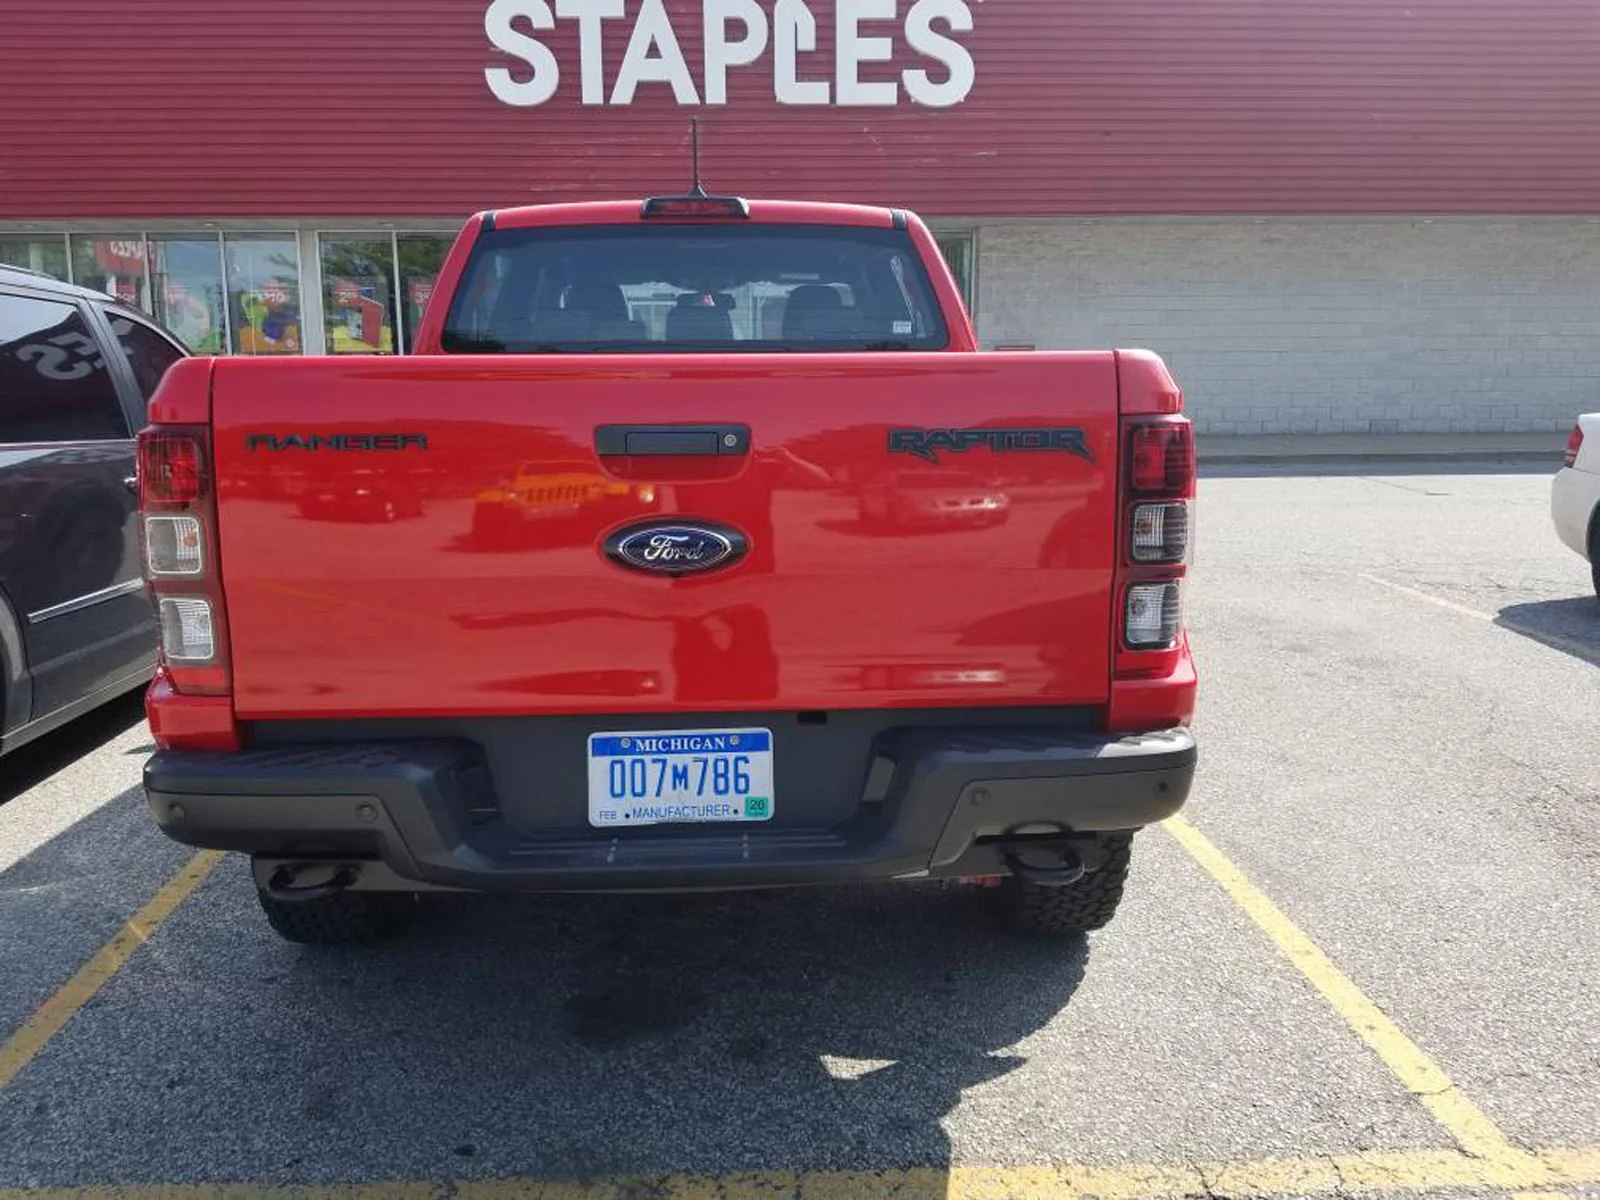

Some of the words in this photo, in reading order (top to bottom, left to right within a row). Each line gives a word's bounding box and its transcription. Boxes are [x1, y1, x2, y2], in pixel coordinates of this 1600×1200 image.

[484, 0, 975, 106] STAPLES
[247, 432, 427, 451] RANGER
[887, 428, 1096, 464] RAPTOR
[643, 534, 704, 560] Ford
[635, 736, 725, 752] MICHIGAN
[609, 755, 750, 798] 007M786
[599, 810, 617, 820] FEB
[632, 804, 731, 819] MANUFACTURER
[749, 799, 765, 810] 20
